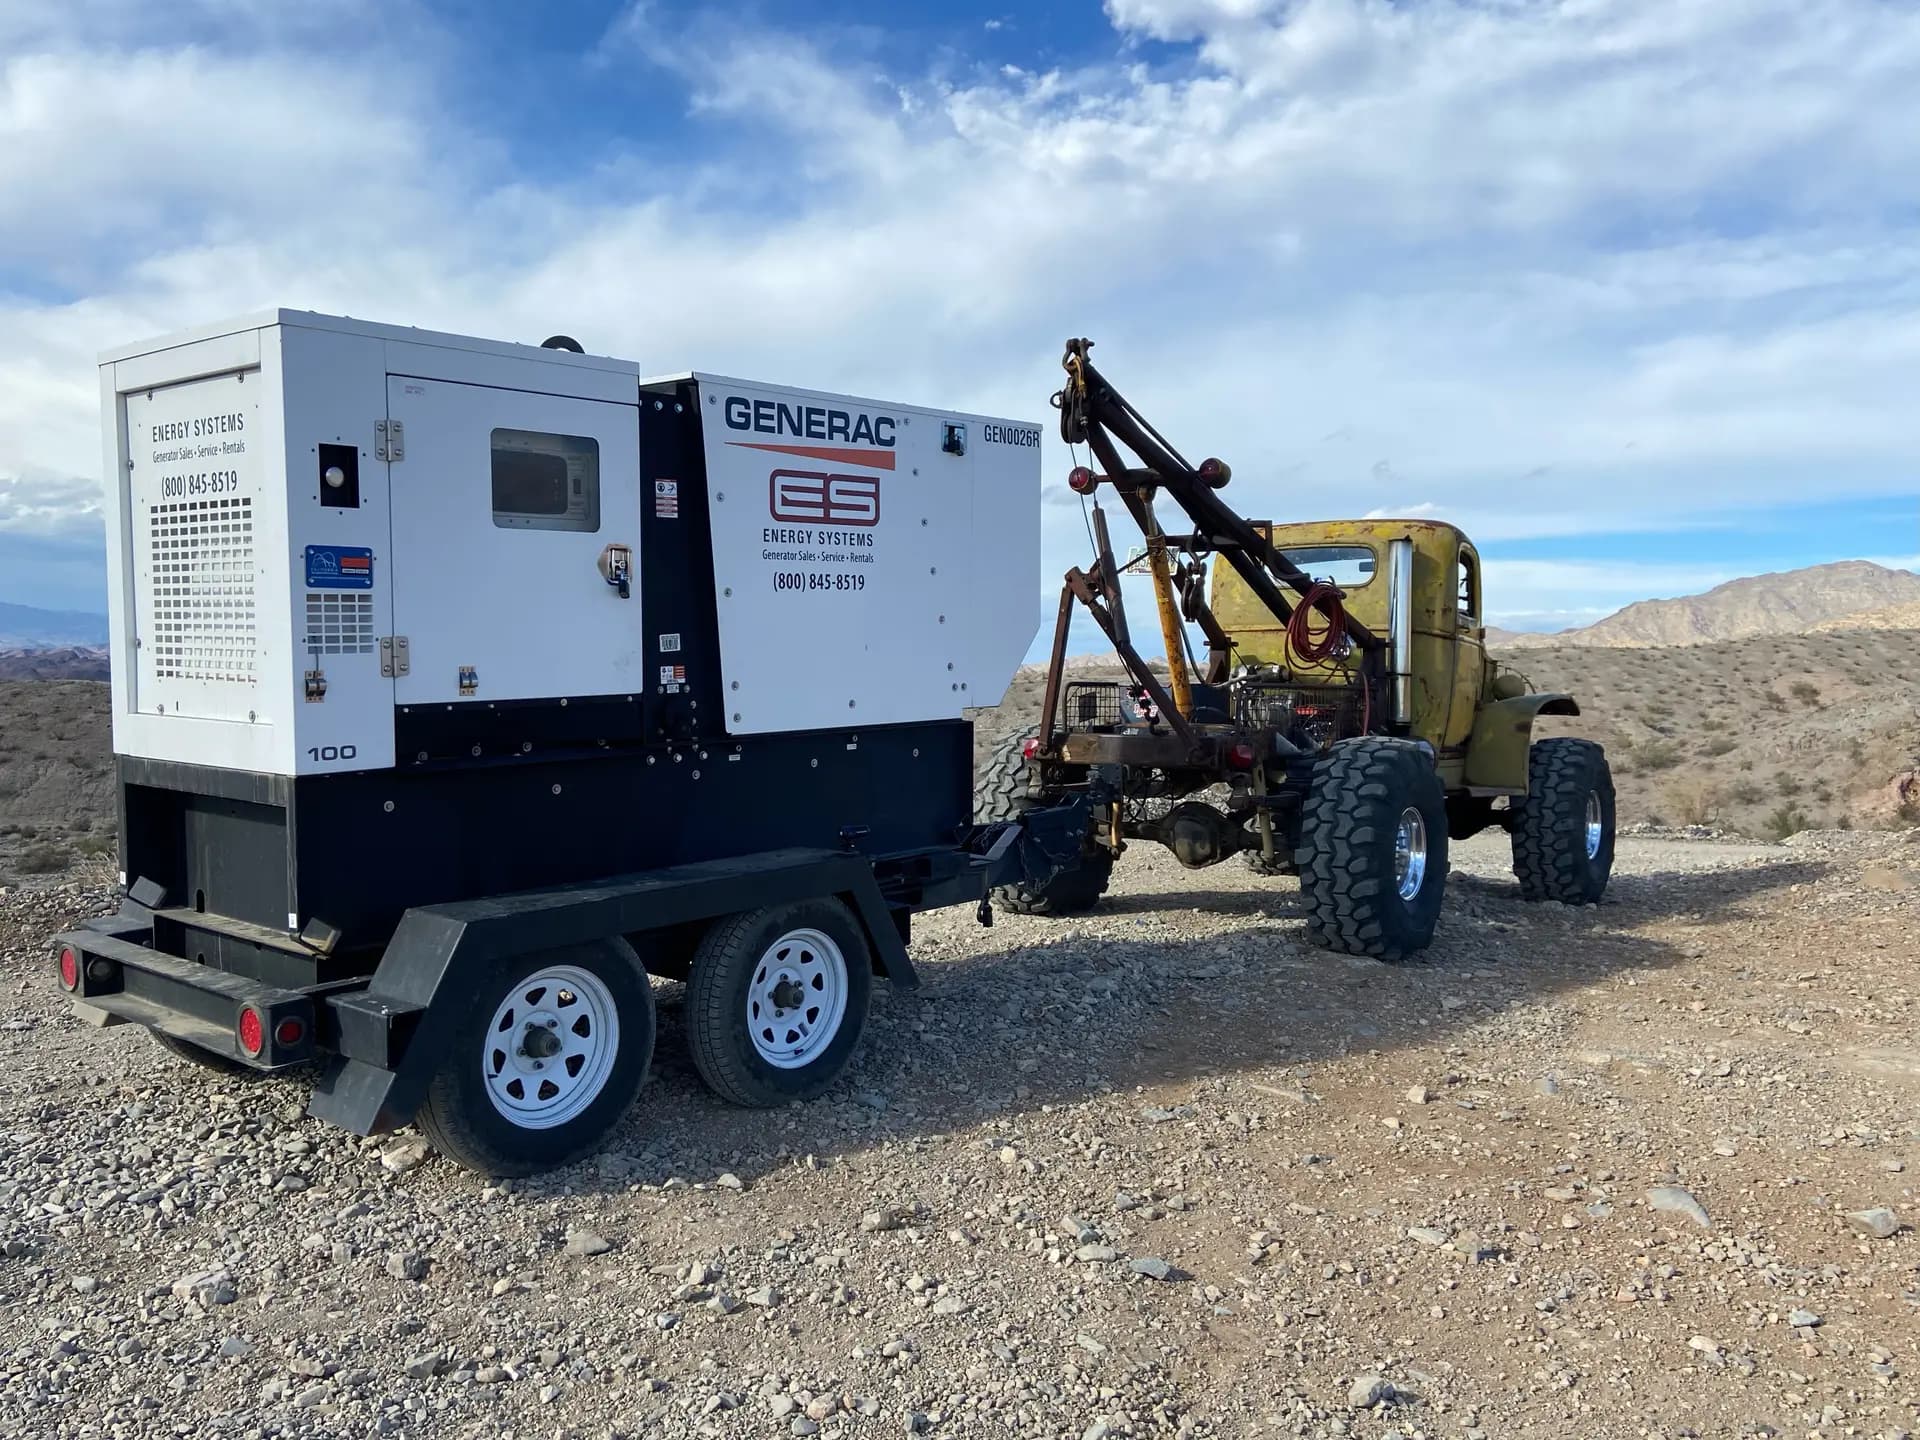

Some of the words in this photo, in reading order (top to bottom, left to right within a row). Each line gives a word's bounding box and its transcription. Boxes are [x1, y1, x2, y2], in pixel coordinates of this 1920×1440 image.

[152, 421, 190, 443] ENERGY
[194, 413, 244, 437] SYSTEMS
[725, 396, 896, 447] GENERAC
[984, 424, 1040, 448] GEN0026R
[152, 450, 178, 463] Generator
[179, 446, 194, 460] Sales
[197, 444, 218, 458] Service
[222, 440, 245, 455] Rentals
[161, 474, 187, 501] (800)
[189, 470, 237, 495] 845-8519
[763, 528, 813, 545] ENERGY
[818, 530, 873, 547] SYSTEMS
[762, 549, 797, 561] Generator
[798, 550, 816, 561] Sales
[821, 551, 845, 562] Service
[850, 552, 874, 563] Rentals
[773, 571, 806, 592] (800)
[809, 573, 865, 591] 845-8519
[308, 745, 356, 761] 100
